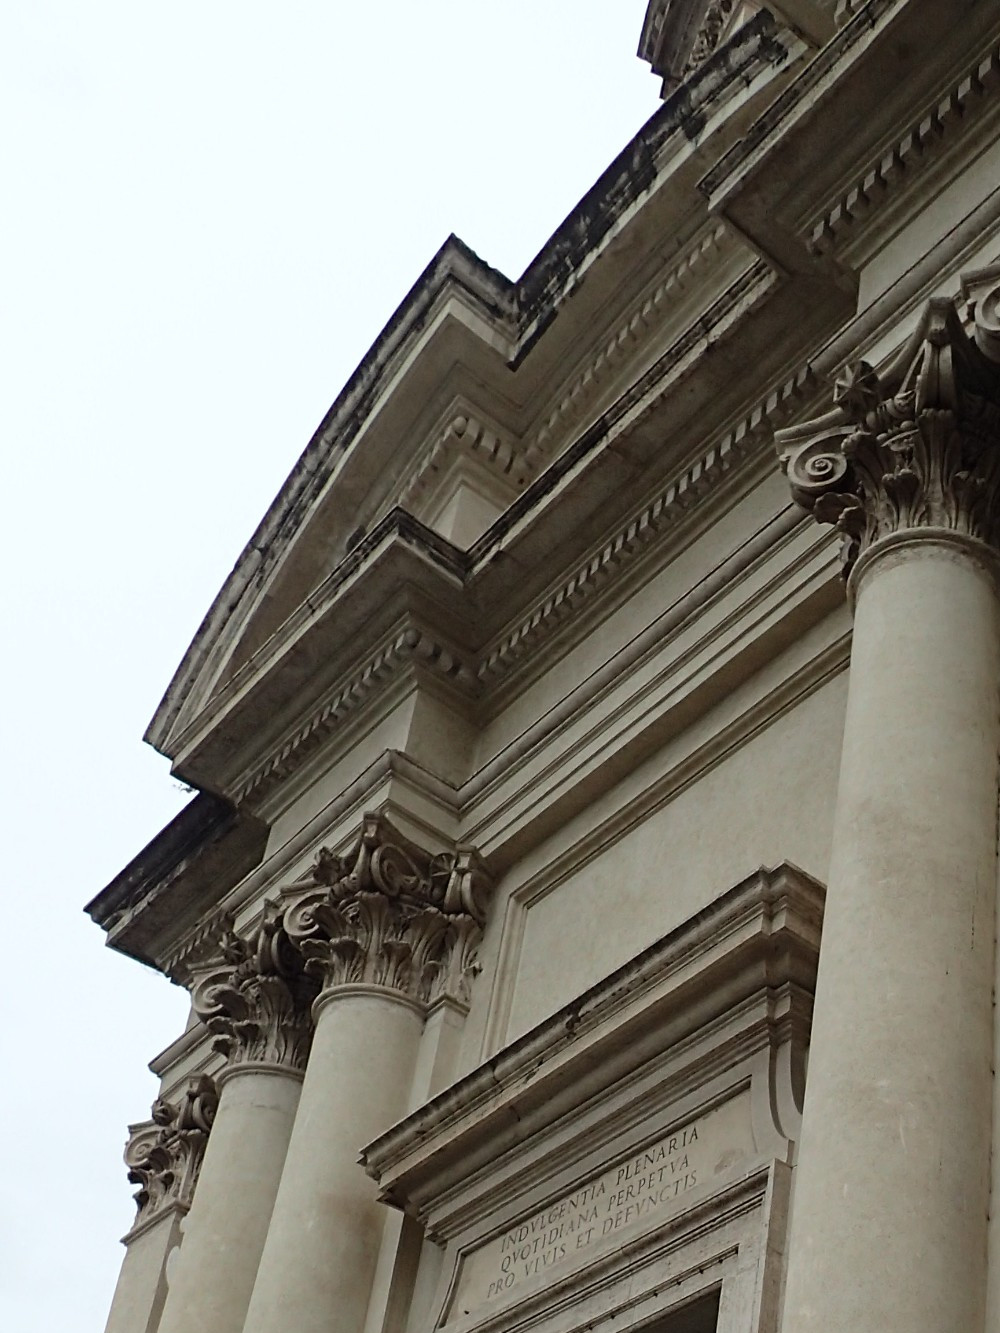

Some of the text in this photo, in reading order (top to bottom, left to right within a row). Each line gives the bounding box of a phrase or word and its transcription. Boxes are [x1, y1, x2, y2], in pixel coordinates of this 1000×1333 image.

[487, 1169, 698, 1299] PRO VIVIS ET DEFVNCTIS
[501, 1126, 699, 1252] INDVLGENTIA PLENARIA
[501, 1154, 689, 1273] QVOTIDIANA PERPETVA
